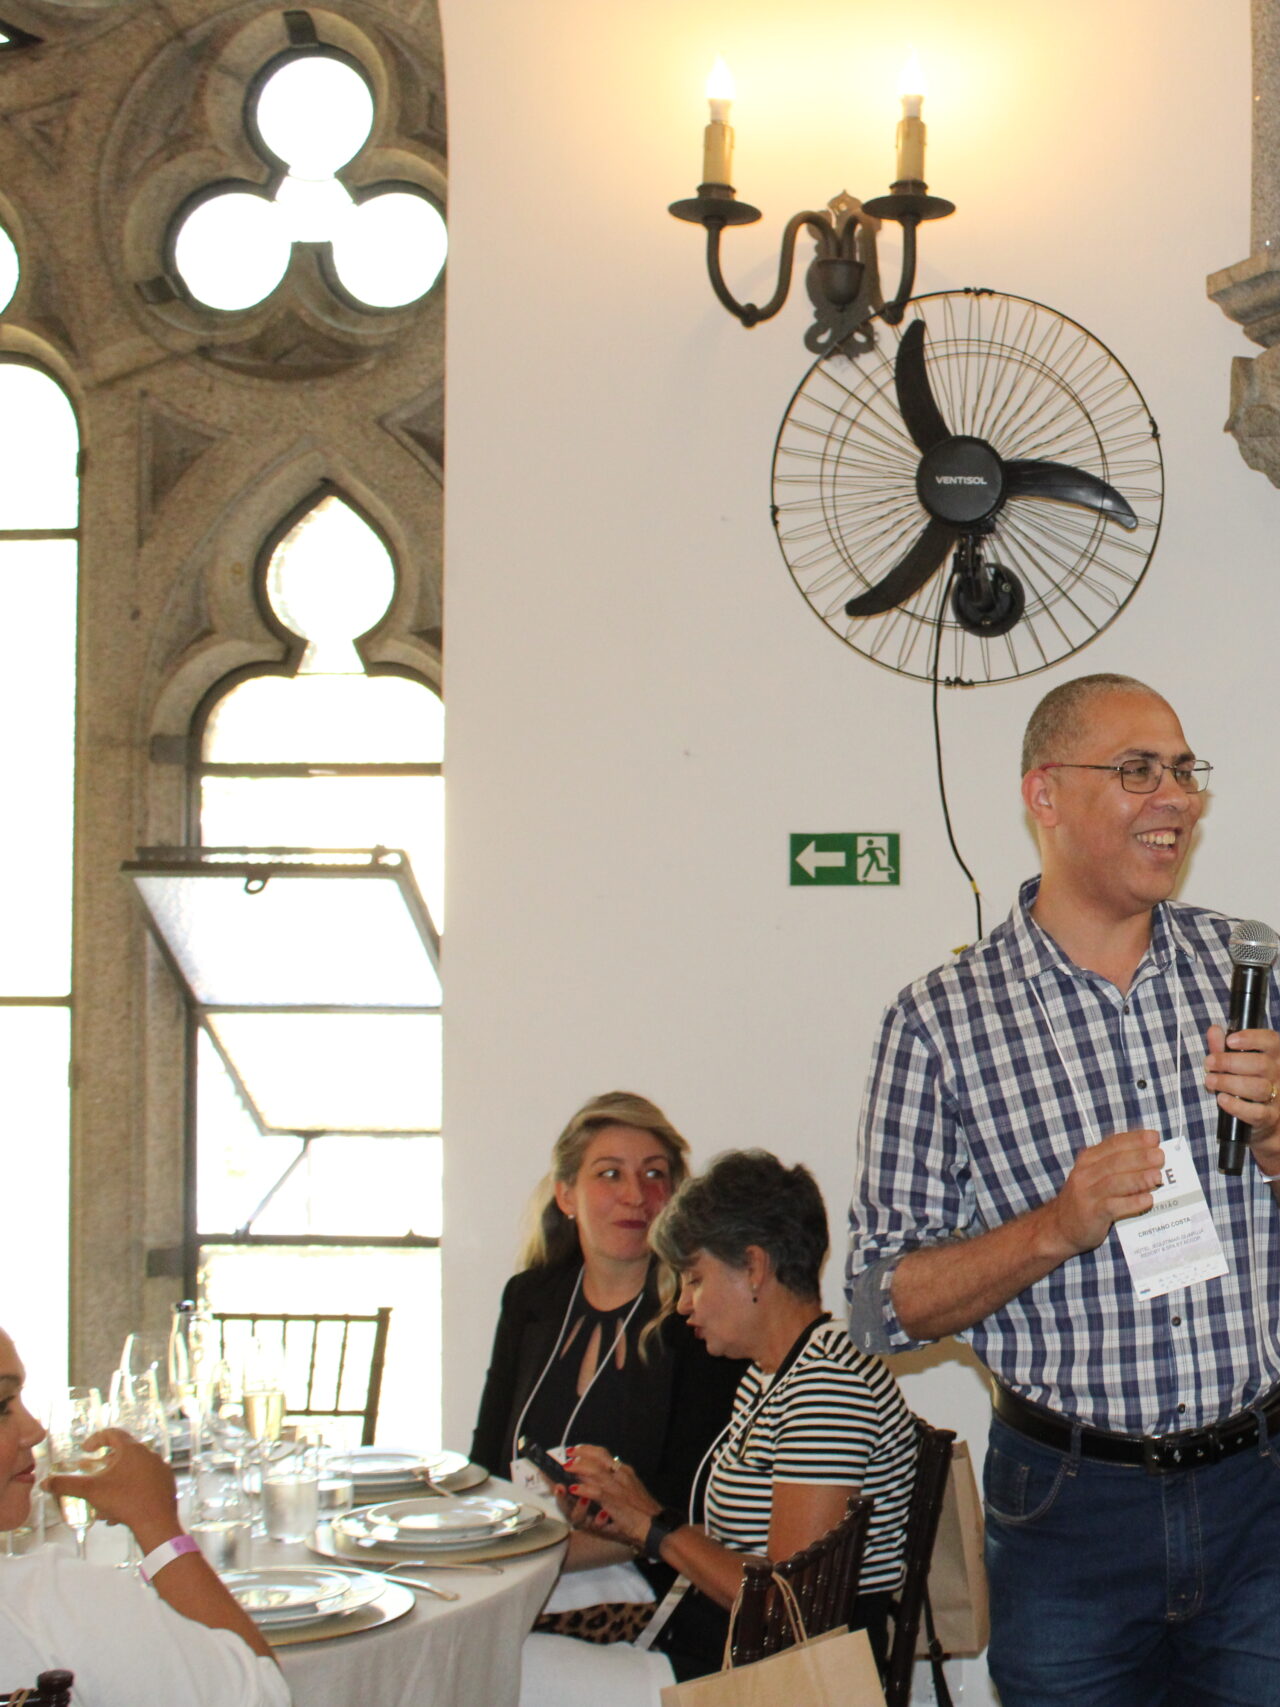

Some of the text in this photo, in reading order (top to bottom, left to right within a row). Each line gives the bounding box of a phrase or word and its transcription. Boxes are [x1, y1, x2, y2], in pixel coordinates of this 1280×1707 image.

[935, 475, 988, 486] VENTISOL
[1138, 1217, 1191, 1238] CRISTIANO COSTA
